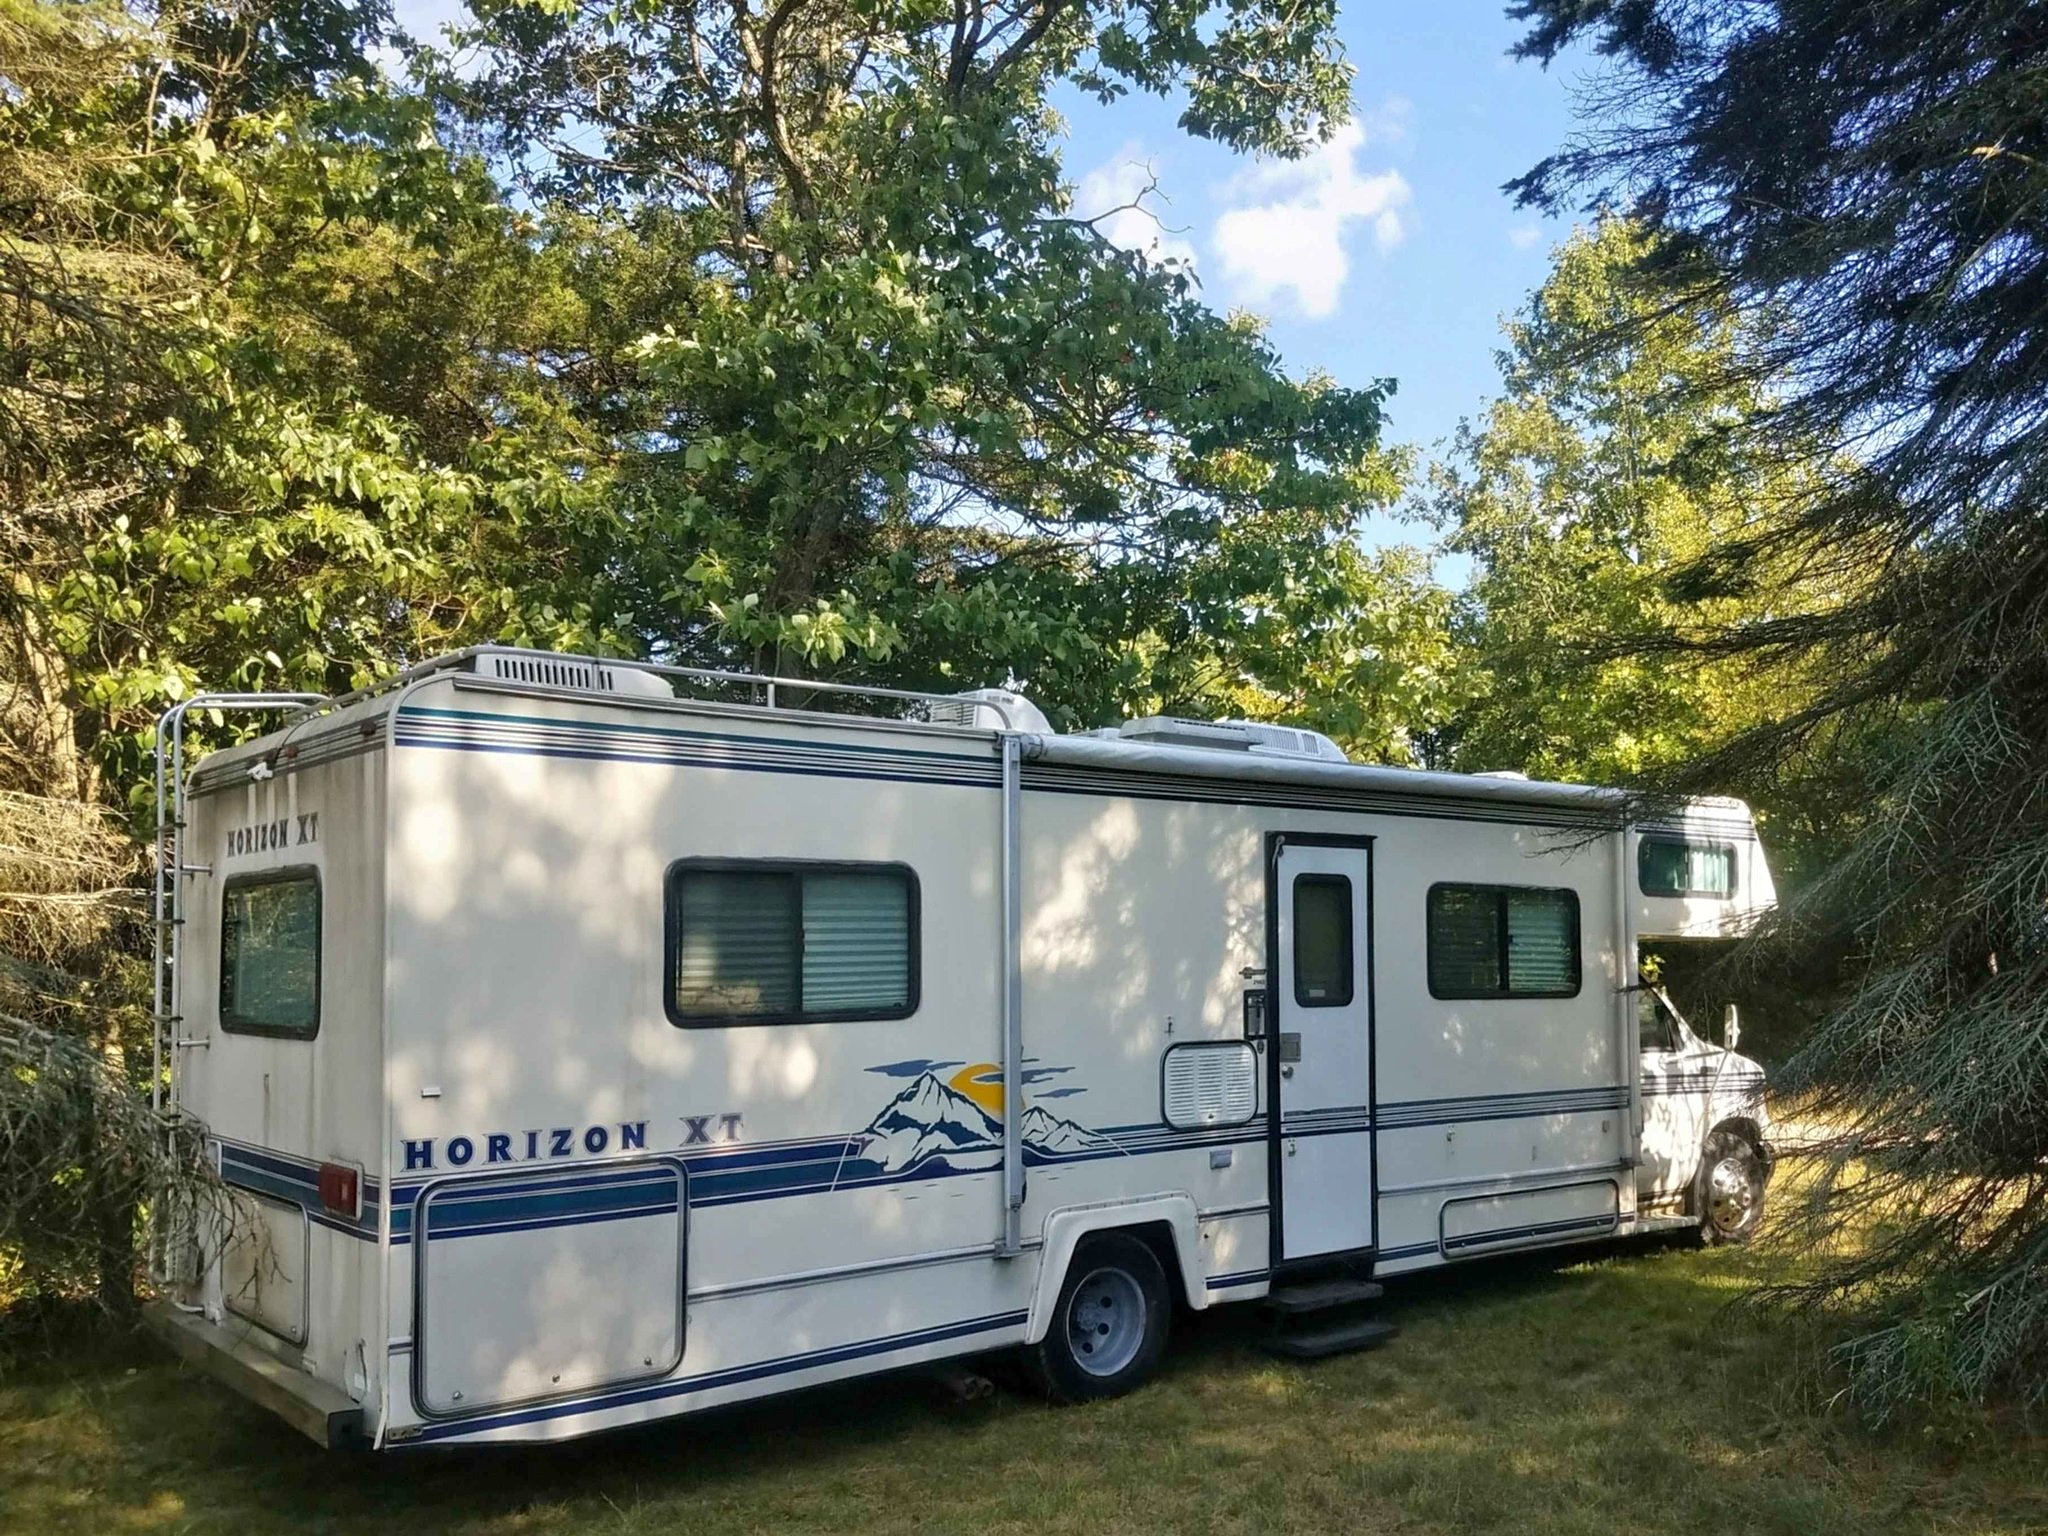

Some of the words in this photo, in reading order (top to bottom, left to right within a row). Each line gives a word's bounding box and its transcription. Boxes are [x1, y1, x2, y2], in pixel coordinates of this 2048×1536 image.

[227, 819, 288, 857] HORIZON
[297, 812, 318, 845] XT
[401, 1120, 650, 1172] HORIZON
[679, 1112, 744, 1147] XT
